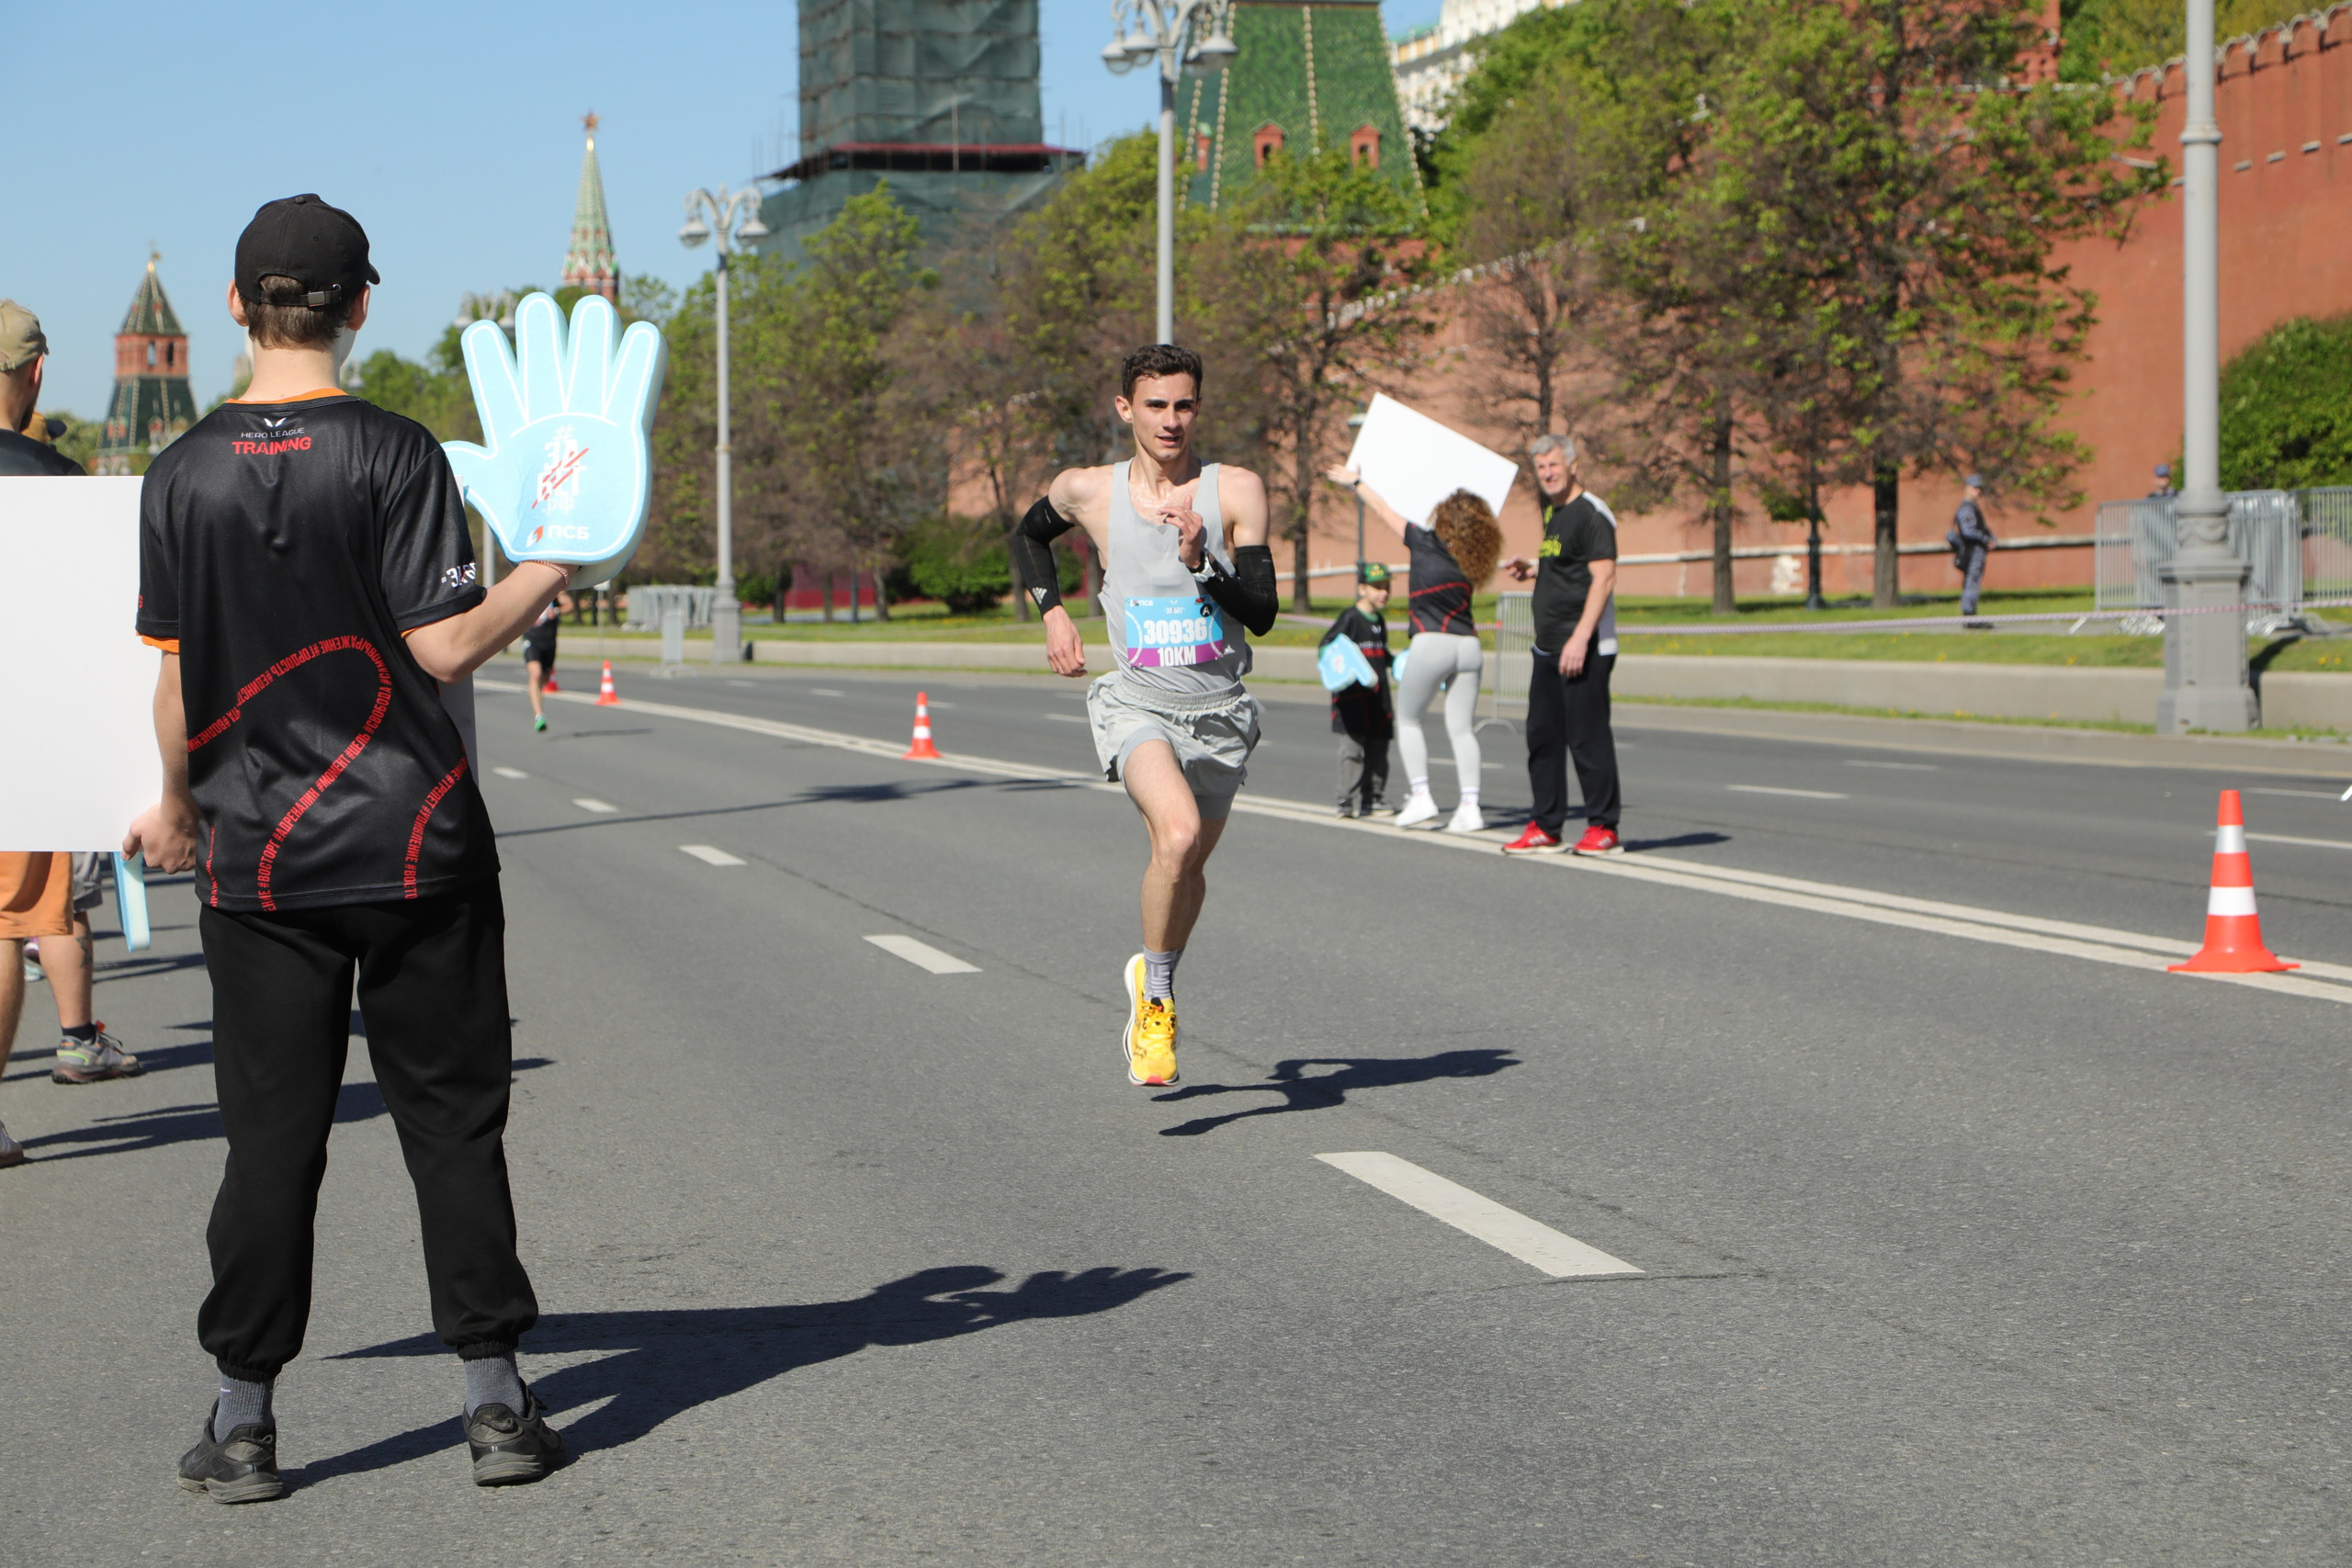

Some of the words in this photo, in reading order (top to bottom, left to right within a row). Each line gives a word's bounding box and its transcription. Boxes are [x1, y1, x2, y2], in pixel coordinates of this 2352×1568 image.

[232, 436, 312, 456] TRAINING
[270, 427, 305, 437] LEAGUE
[548, 525, 589, 540] ПСБ
[1143, 618, 1207, 644] 30936
[269, 643, 320, 677] #ГОРДОСТЬ
[319, 636, 392, 685] #САМОВЫРАЖЕНИЕ
[1157, 646, 1196, 668] 10KM
[363, 686, 392, 735] #СВОБОДА
[344, 732, 371, 760] #ЦЕЛЬ
[314, 753, 351, 793] #МОМЕНТ
[424, 773, 456, 809] #ТРЕПЕТ
[272, 787, 321, 842] #АДРЕНАЛИН
[404, 805, 433, 863] #УДИВЛЕНИЕ
[257, 839, 280, 888] #ВОСТОРГ
